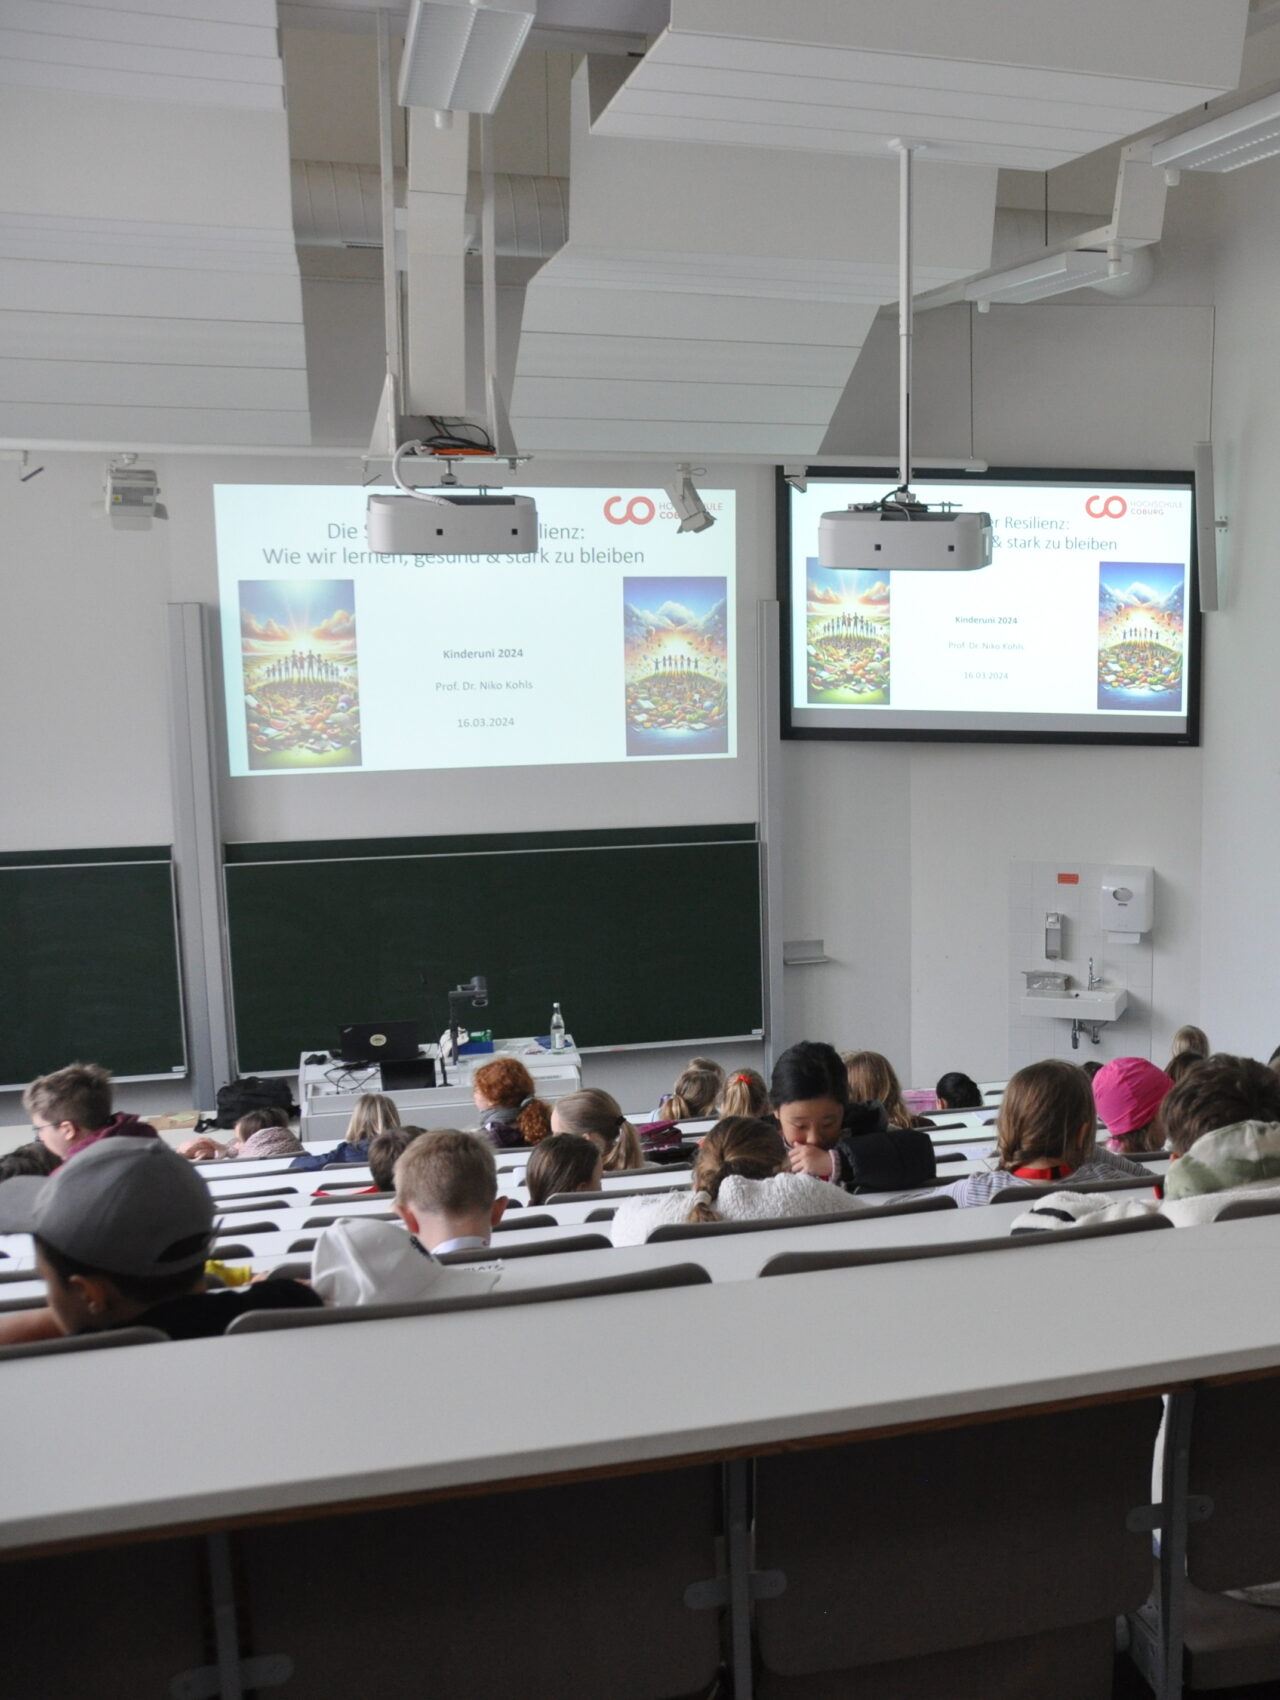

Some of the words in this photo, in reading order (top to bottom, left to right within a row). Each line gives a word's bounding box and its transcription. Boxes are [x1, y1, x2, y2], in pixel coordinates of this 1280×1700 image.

[1005, 516, 1070, 531] Resilienz:
[327, 523, 358, 539] Die
[539, 523, 585, 540] lienz:
[1006, 537, 1041, 549] stark
[1045, 539, 1061, 550] zu
[1065, 537, 1118, 551] bleiben
[262, 548, 301, 564] Wie
[306, 548, 337, 564] wir
[343, 547, 408, 566] lernen,
[506, 548, 550, 564] stark
[554, 551, 574, 564] zu
[580, 547, 645, 564] bleiben
[955, 616, 995, 625] Kinderuni
[998, 616, 1018, 625] 2024
[443, 648, 495, 659] Kinderuni
[497, 648, 524, 658] 2024
[435, 682, 460, 692] Prof.
[462, 681, 477, 691] Dr.
[480, 680, 503, 691] Niko
[505, 680, 534, 690] Kohls
[457, 717, 515, 728] 16.03.2024
